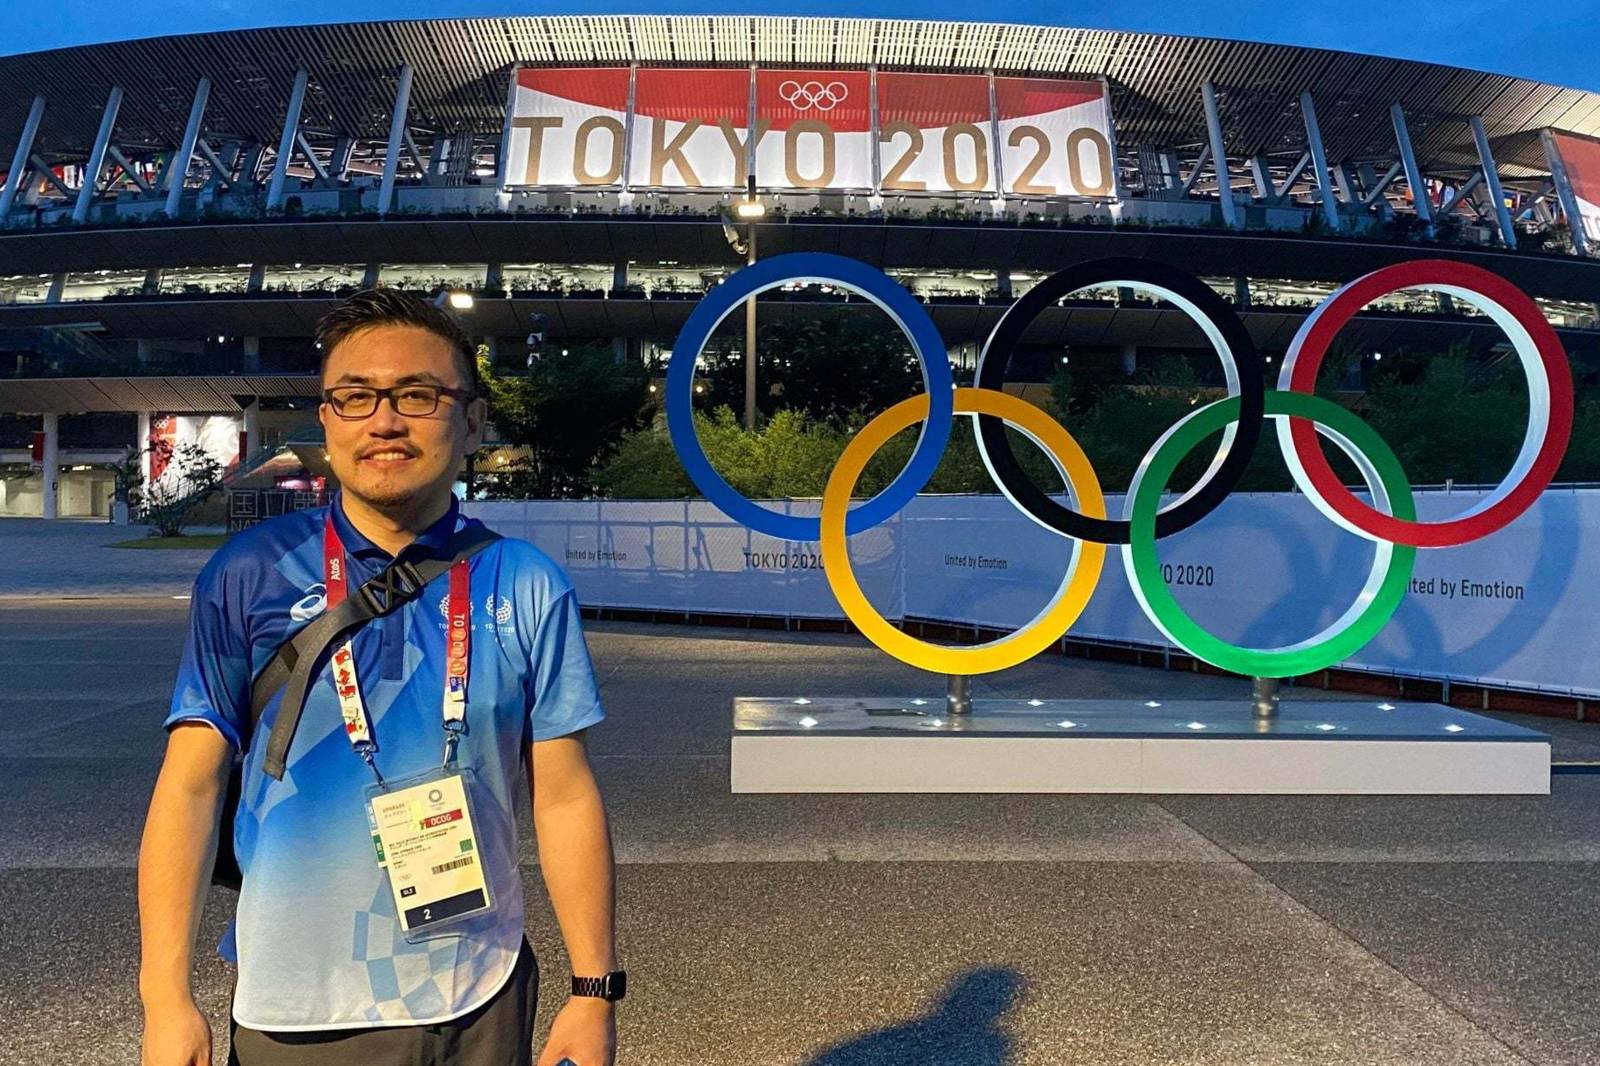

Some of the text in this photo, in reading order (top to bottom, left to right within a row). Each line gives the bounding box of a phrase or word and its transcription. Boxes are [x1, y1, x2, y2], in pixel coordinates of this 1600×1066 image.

[512, 116, 1113, 197] TOKYO 2020
[743, 552, 787, 568] TOKYO
[945, 554, 1007, 569] United by Emotion
[1177, 564, 1214, 587] 2020
[1406, 577, 1524, 600] ited by Emotion
[431, 814, 452, 825] OCOG
[423, 908, 432, 920] 2
